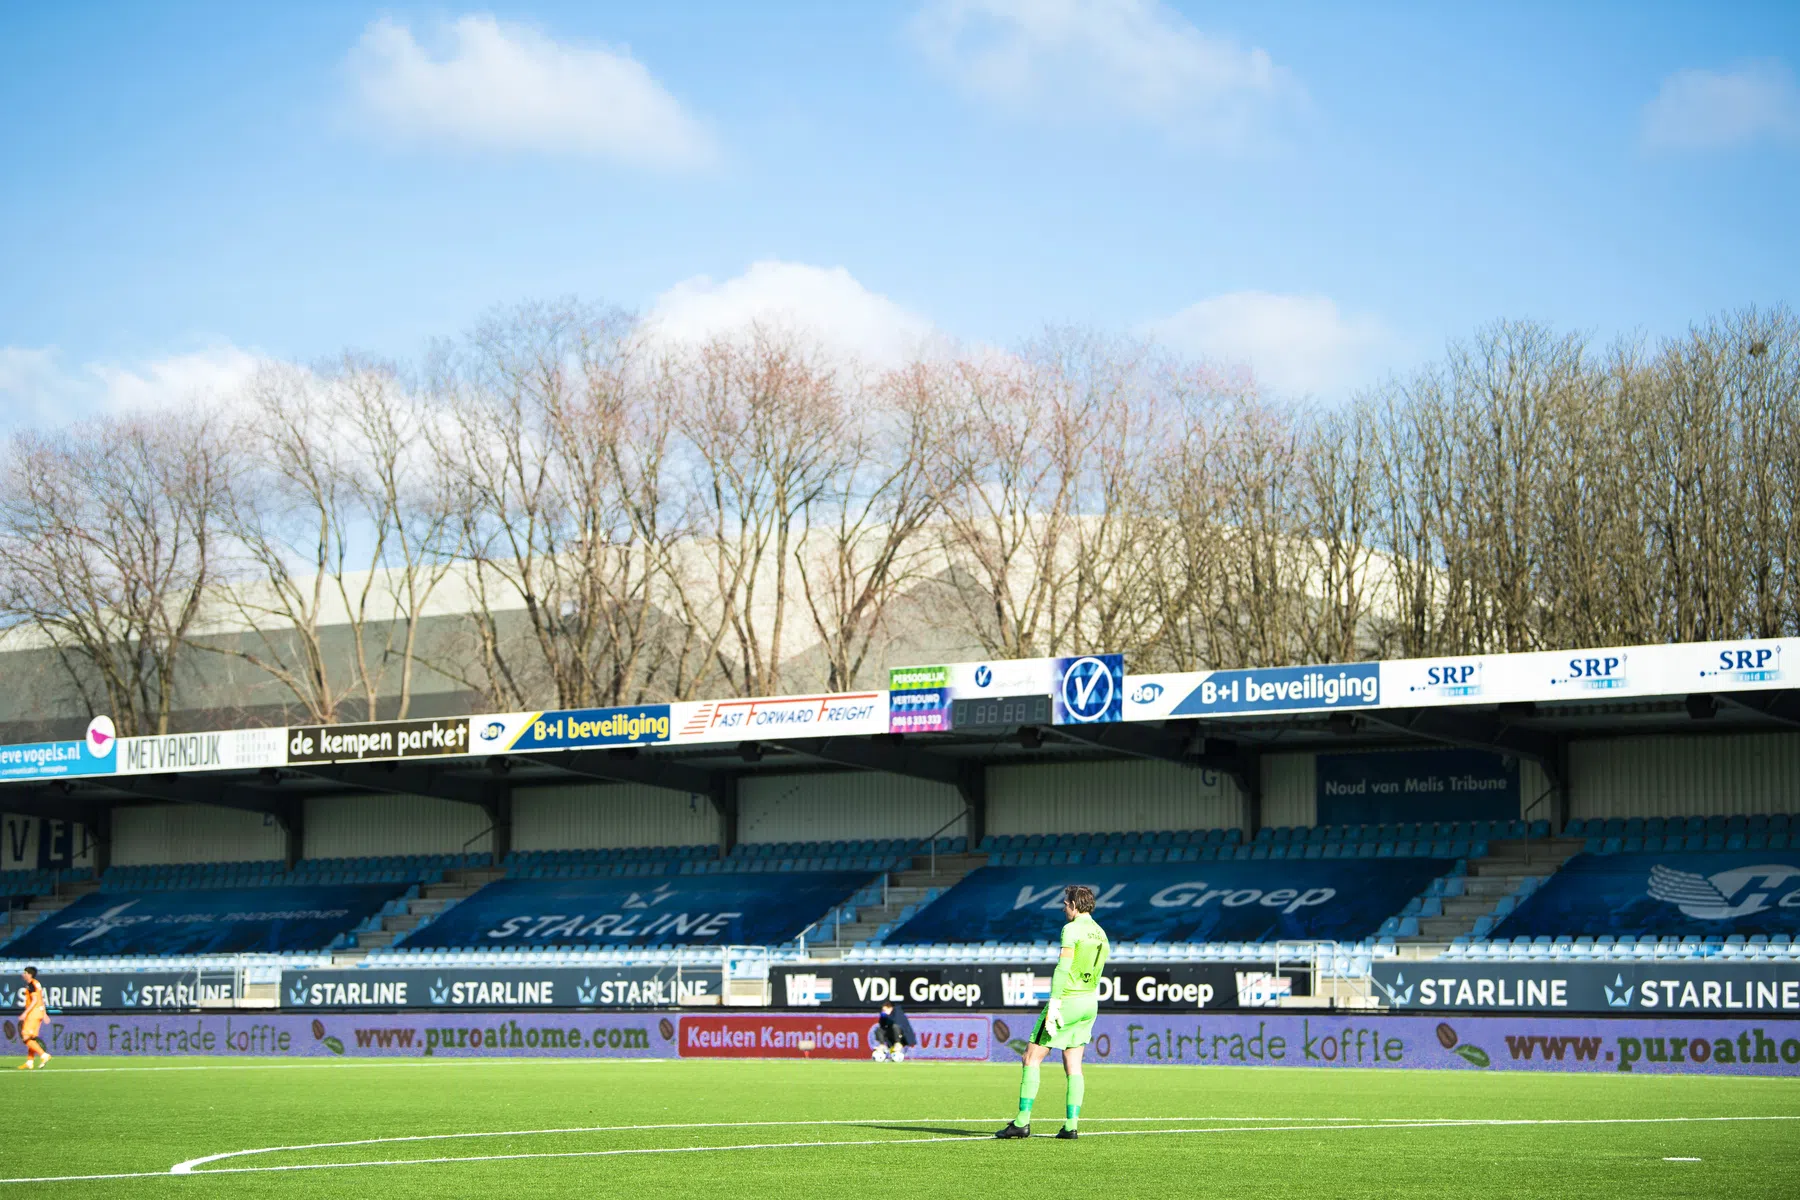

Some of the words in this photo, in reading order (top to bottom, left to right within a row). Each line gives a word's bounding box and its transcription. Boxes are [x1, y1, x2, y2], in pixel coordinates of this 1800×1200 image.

[1569, 657, 1619, 678] SRP
[1719, 649, 1772, 670] SRP
[1201, 677, 1238, 704] B+I
[1246, 671, 1378, 705] beveiliging
[1427, 665, 1475, 685] SRP
[534, 719, 564, 740] B+I
[568, 713, 670, 740] beveiliging
[710, 703, 743, 727] FAST
[746, 701, 814, 726] FORWARD
[817, 699, 875, 722] FREIGHT
[127, 734, 221, 770] METVANDIJK
[290, 726, 314, 755] de
[320, 728, 396, 759] kempen
[398, 722, 468, 757] parket
[1325, 780, 1366, 796] Noud
[1371, 781, 1399, 794] van
[1404, 776, 1444, 792] Melis
[1449, 775, 1507, 792] Tribune
[1149, 882, 1336, 914] Groep
[487, 912, 743, 938] STARLINE
[1093, 943, 1103, 968] 1
[17, 986, 102, 1007] SARLINE
[310, 982, 408, 1006] STARLINE
[451, 981, 554, 1004] STARLINE
[852, 977, 904, 1002] VDL
[909, 978, 981, 1007] Groep
[1001, 972, 1039, 1006] VDL
[1096, 976, 1130, 1002] DL
[1135, 976, 1214, 1008] Groep
[1419, 978, 1568, 1007] STARLINE
[1640, 980, 1800, 1009] STARLINE
[52, 1023, 98, 1052] Puro
[108, 1018, 217, 1052] Fairtrade
[225, 1017, 291, 1052] koffie
[355, 1020, 649, 1055] www.puroathome.com
[687, 1025, 756, 1049] Keuken
[761, 1024, 859, 1050] Kampioen
[1127, 1021, 1286, 1061] Fairtrade
[1304, 1018, 1404, 1062] koffie
